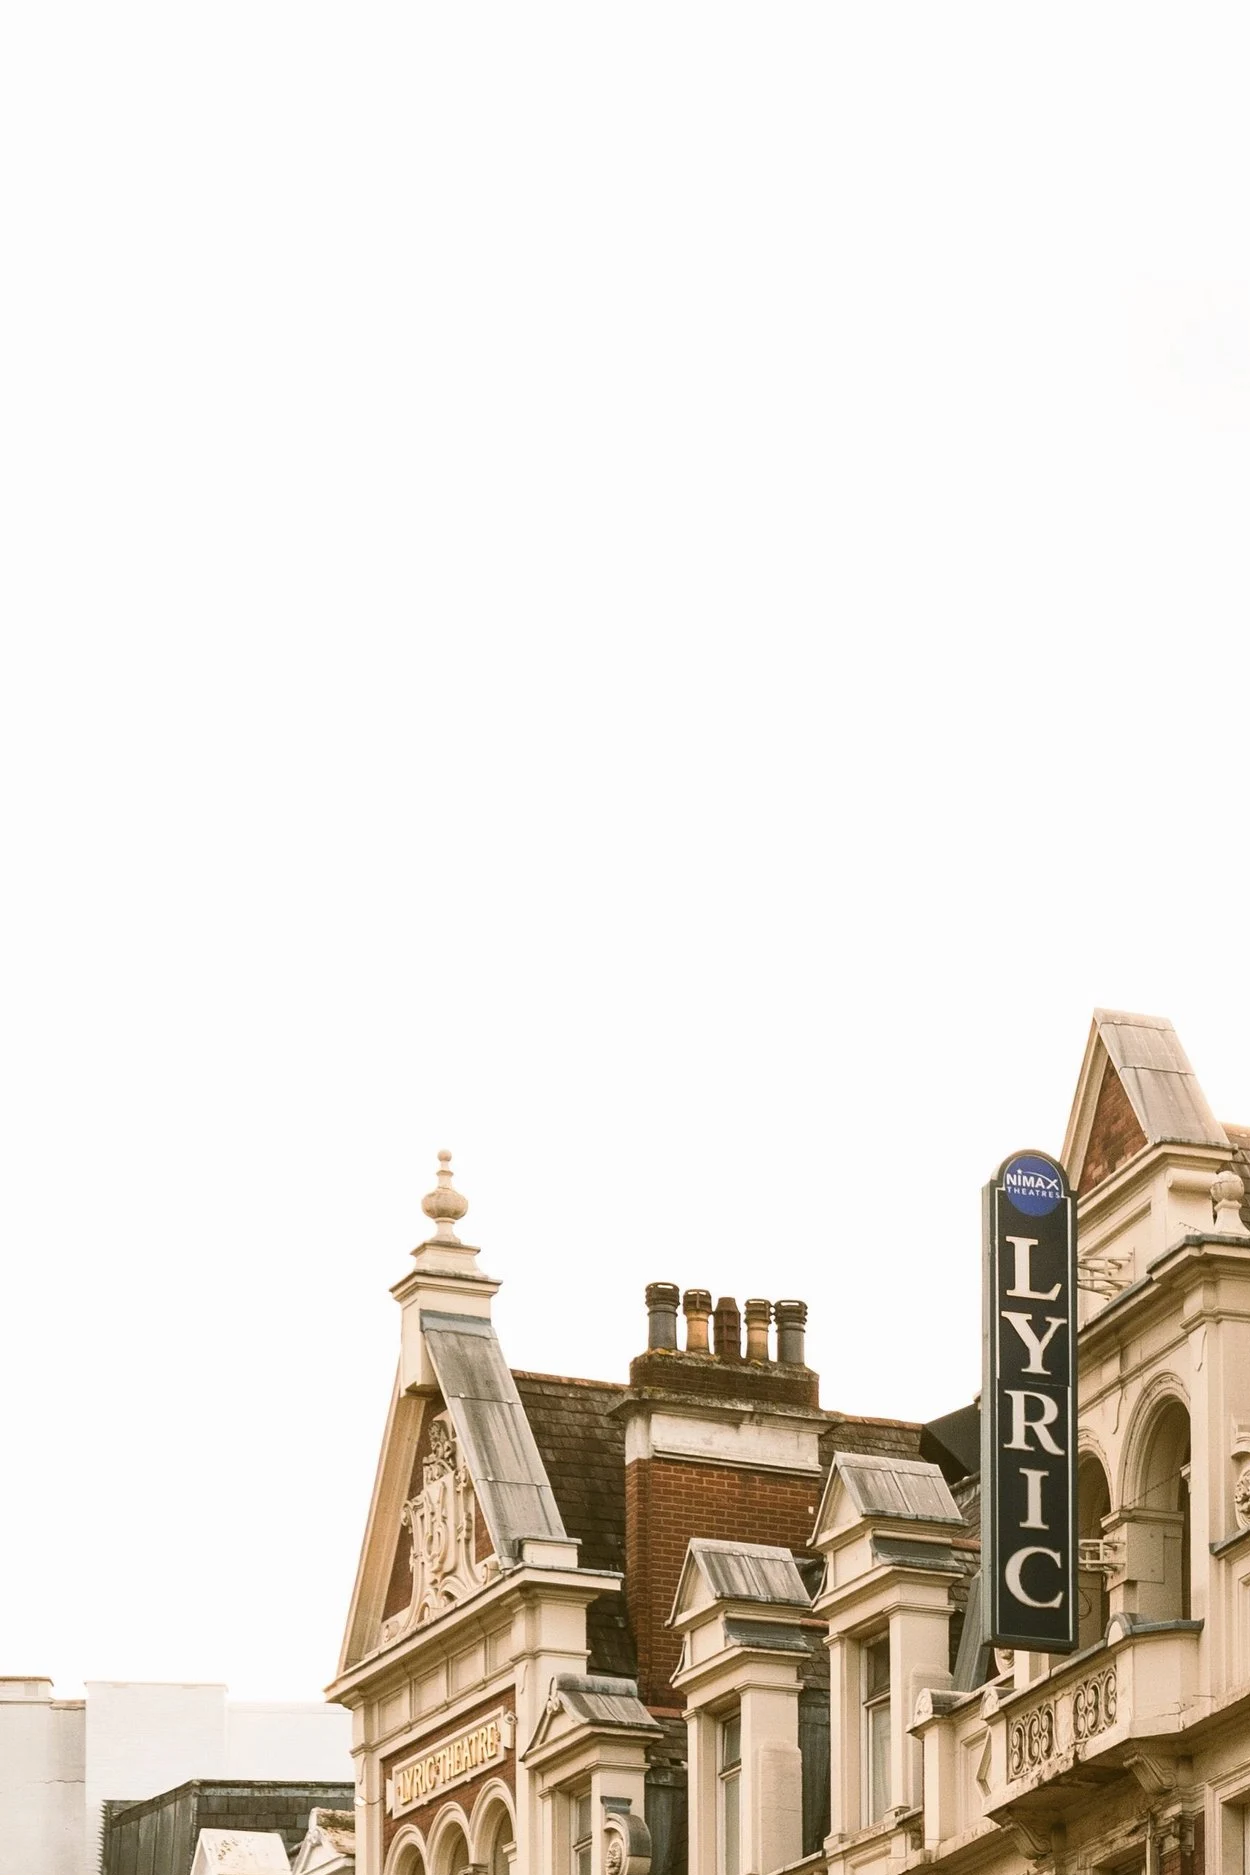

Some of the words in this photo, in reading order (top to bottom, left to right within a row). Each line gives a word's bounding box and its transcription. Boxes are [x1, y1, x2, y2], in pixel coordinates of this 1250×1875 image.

[1007, 1186, 1060, 1199] THEATRES
[1001, 1235, 1067, 1610] LYRIC
[400, 1757, 436, 1806] LYRIC
[437, 1721, 497, 1784] THEATRE
